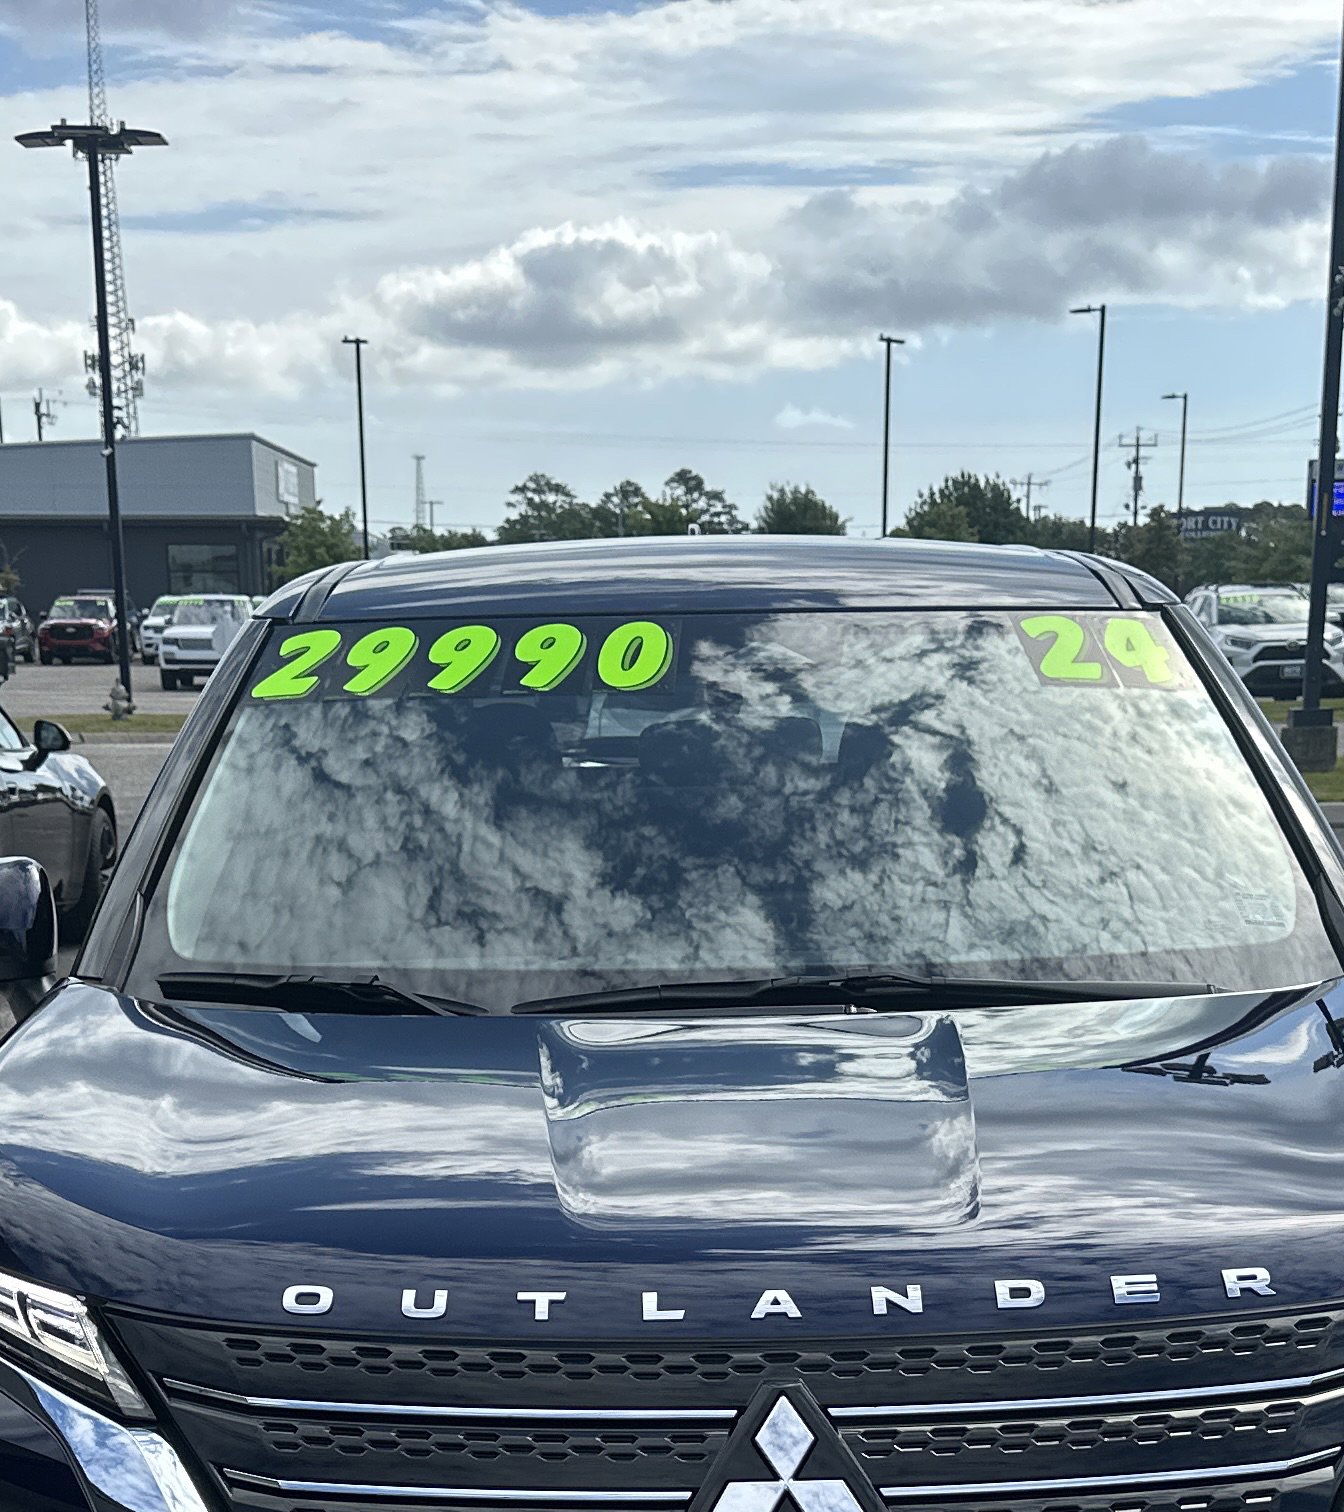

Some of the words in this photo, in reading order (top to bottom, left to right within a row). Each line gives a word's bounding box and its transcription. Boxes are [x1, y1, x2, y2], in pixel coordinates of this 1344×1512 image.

[251, 620, 673, 700] 29990
[1020, 615, 1173, 684] 24
[281, 1266, 1278, 1322] OUTLANDER
